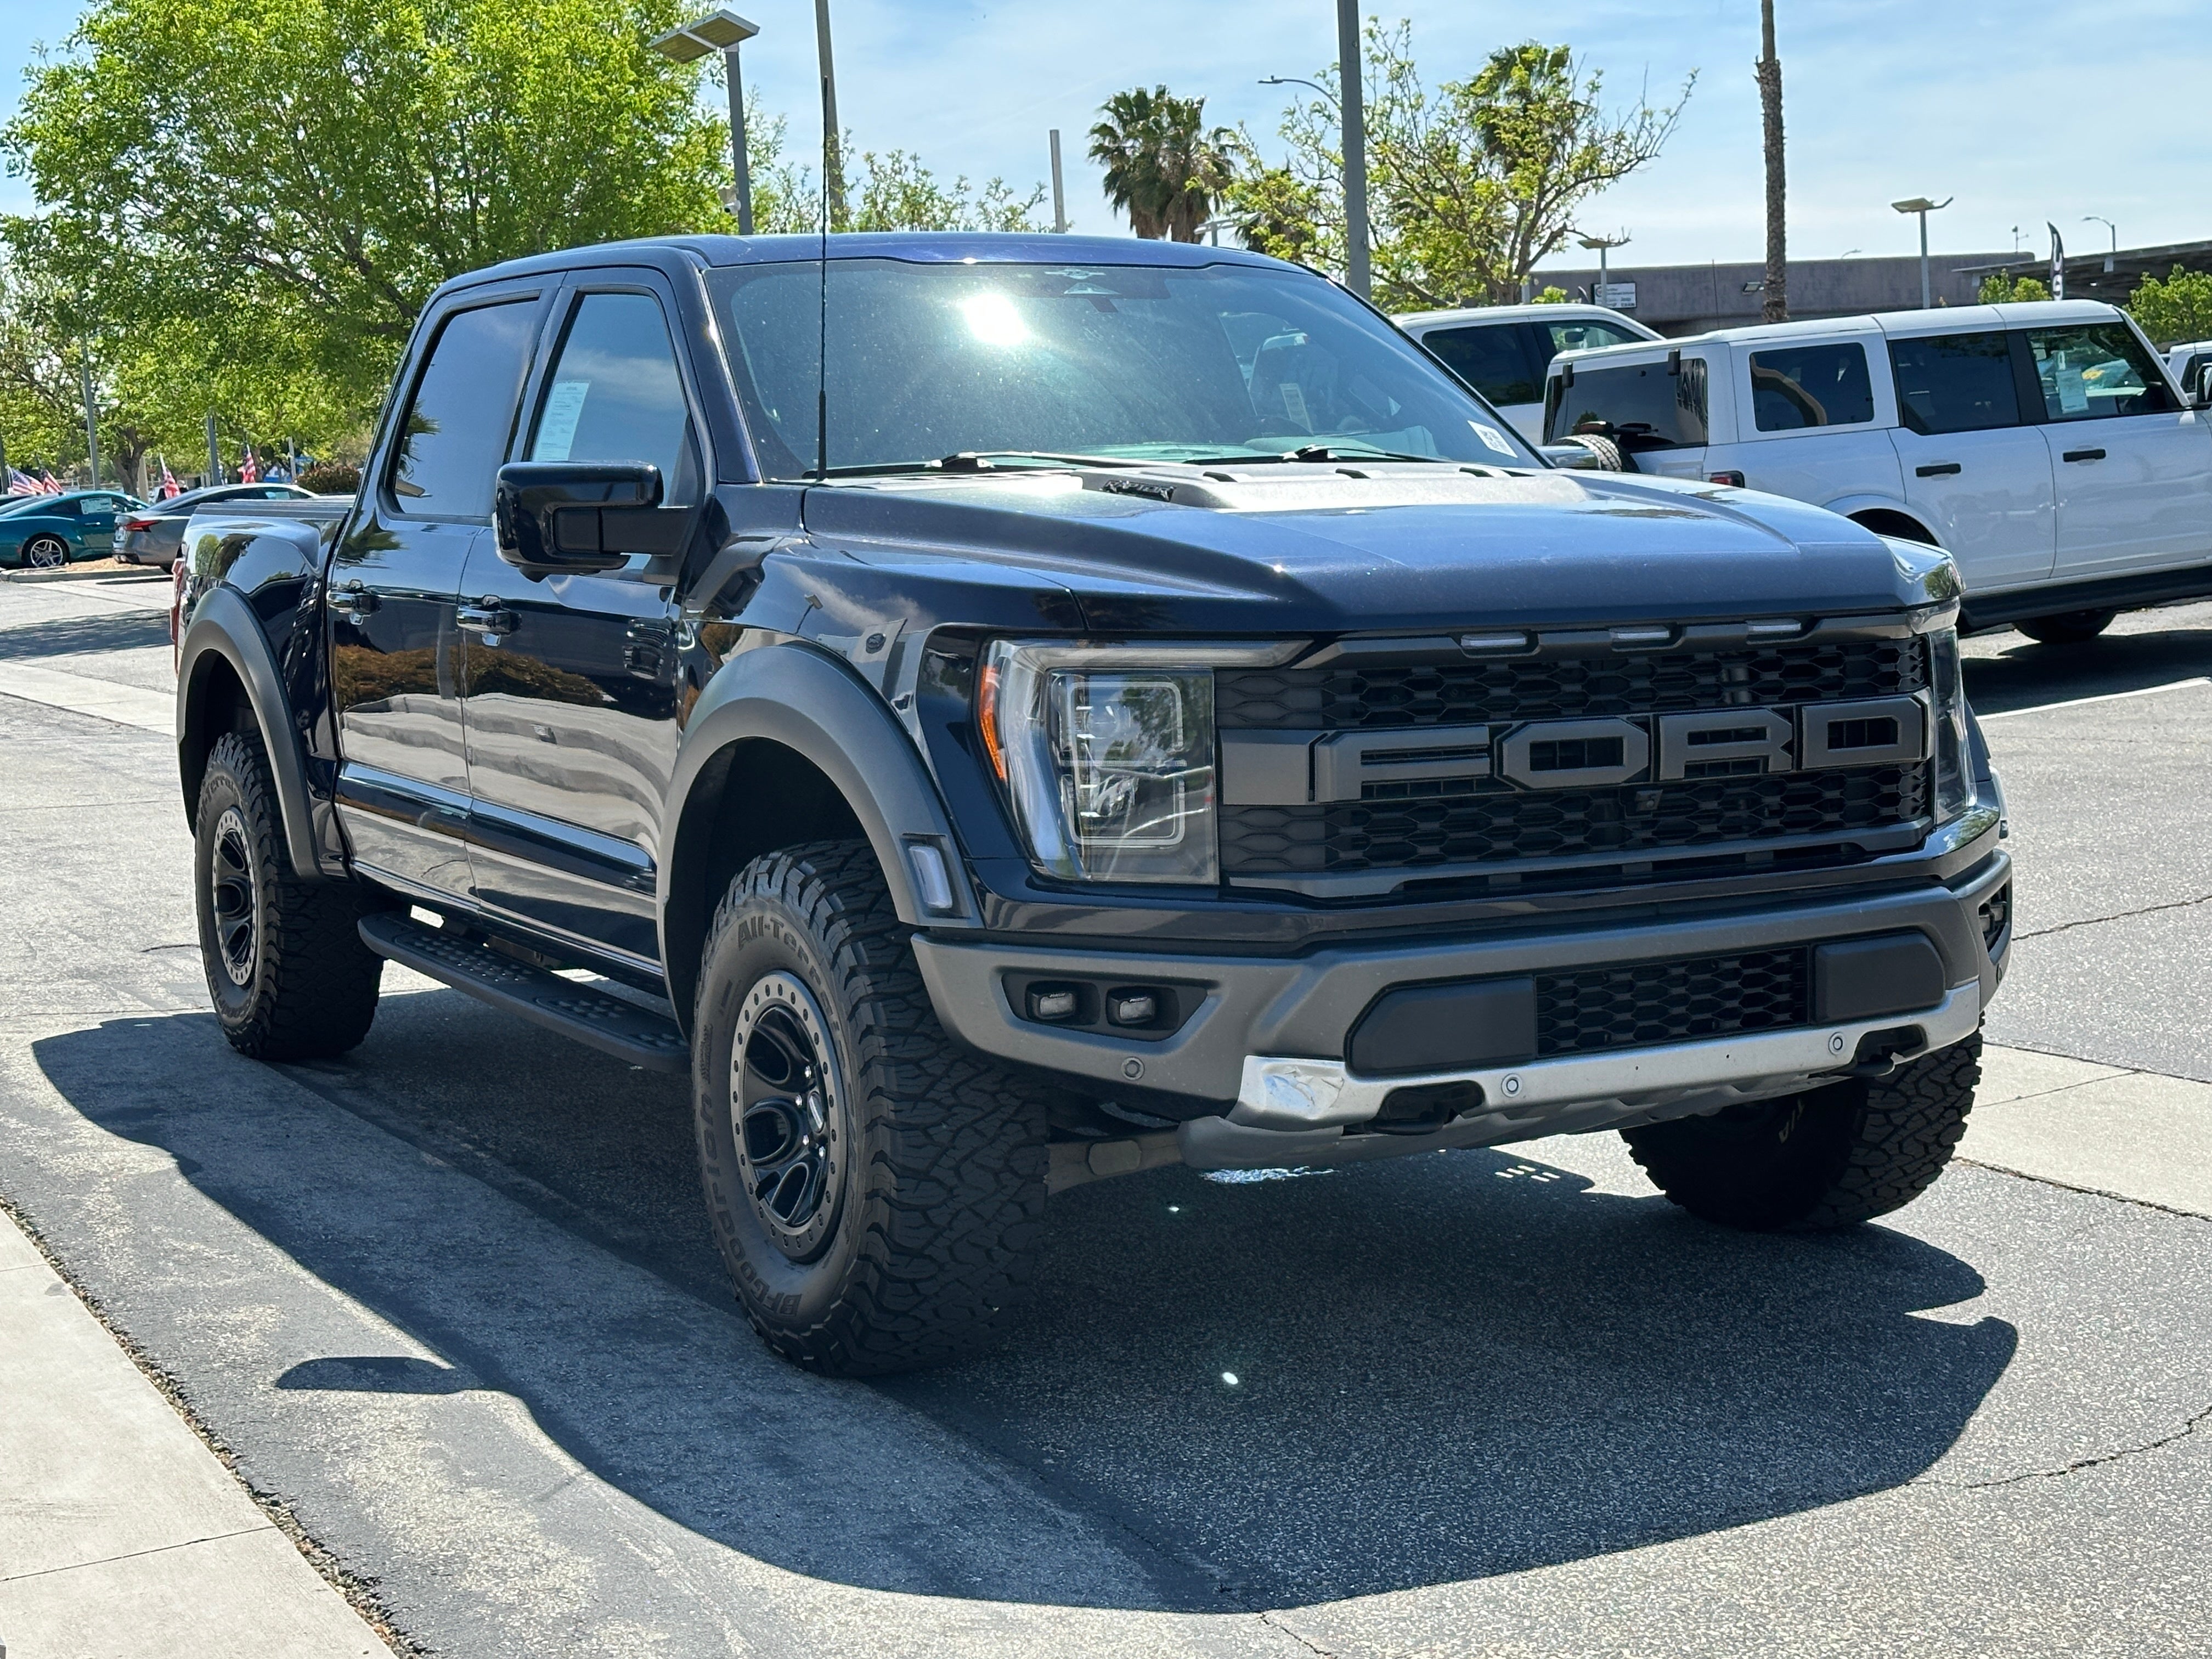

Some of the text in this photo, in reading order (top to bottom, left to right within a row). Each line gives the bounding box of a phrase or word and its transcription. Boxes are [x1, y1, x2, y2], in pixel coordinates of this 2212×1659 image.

[1102, 479, 1177, 502] RAPTOR
[1315, 690, 1929, 804] FORD
[737, 915, 847, 1070] All-Terrain
